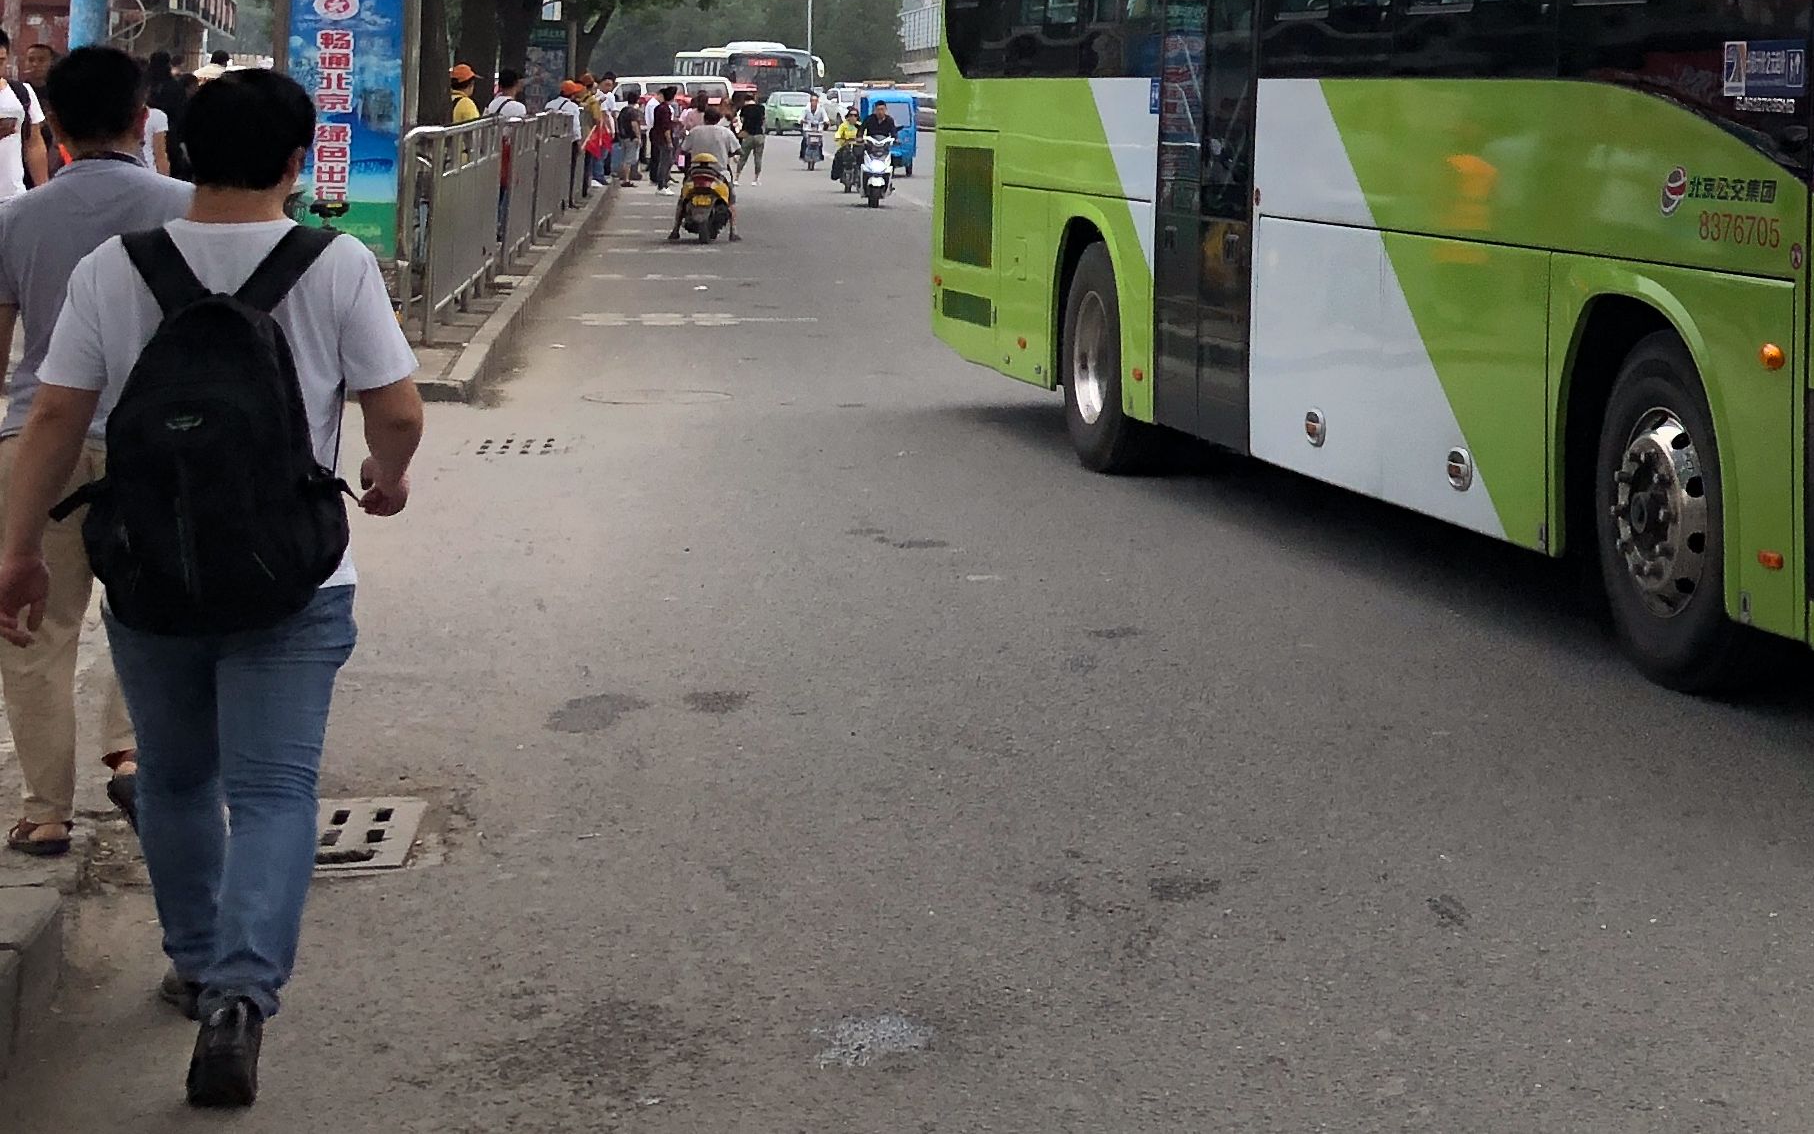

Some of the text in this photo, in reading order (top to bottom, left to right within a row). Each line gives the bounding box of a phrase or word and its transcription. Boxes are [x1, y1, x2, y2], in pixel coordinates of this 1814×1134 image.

[315, 30, 353, 202] 畅通北京 绿色出行
[1687, 176, 1778, 204] 北京公交集团
[1699, 210, 1780, 248] 8376705
